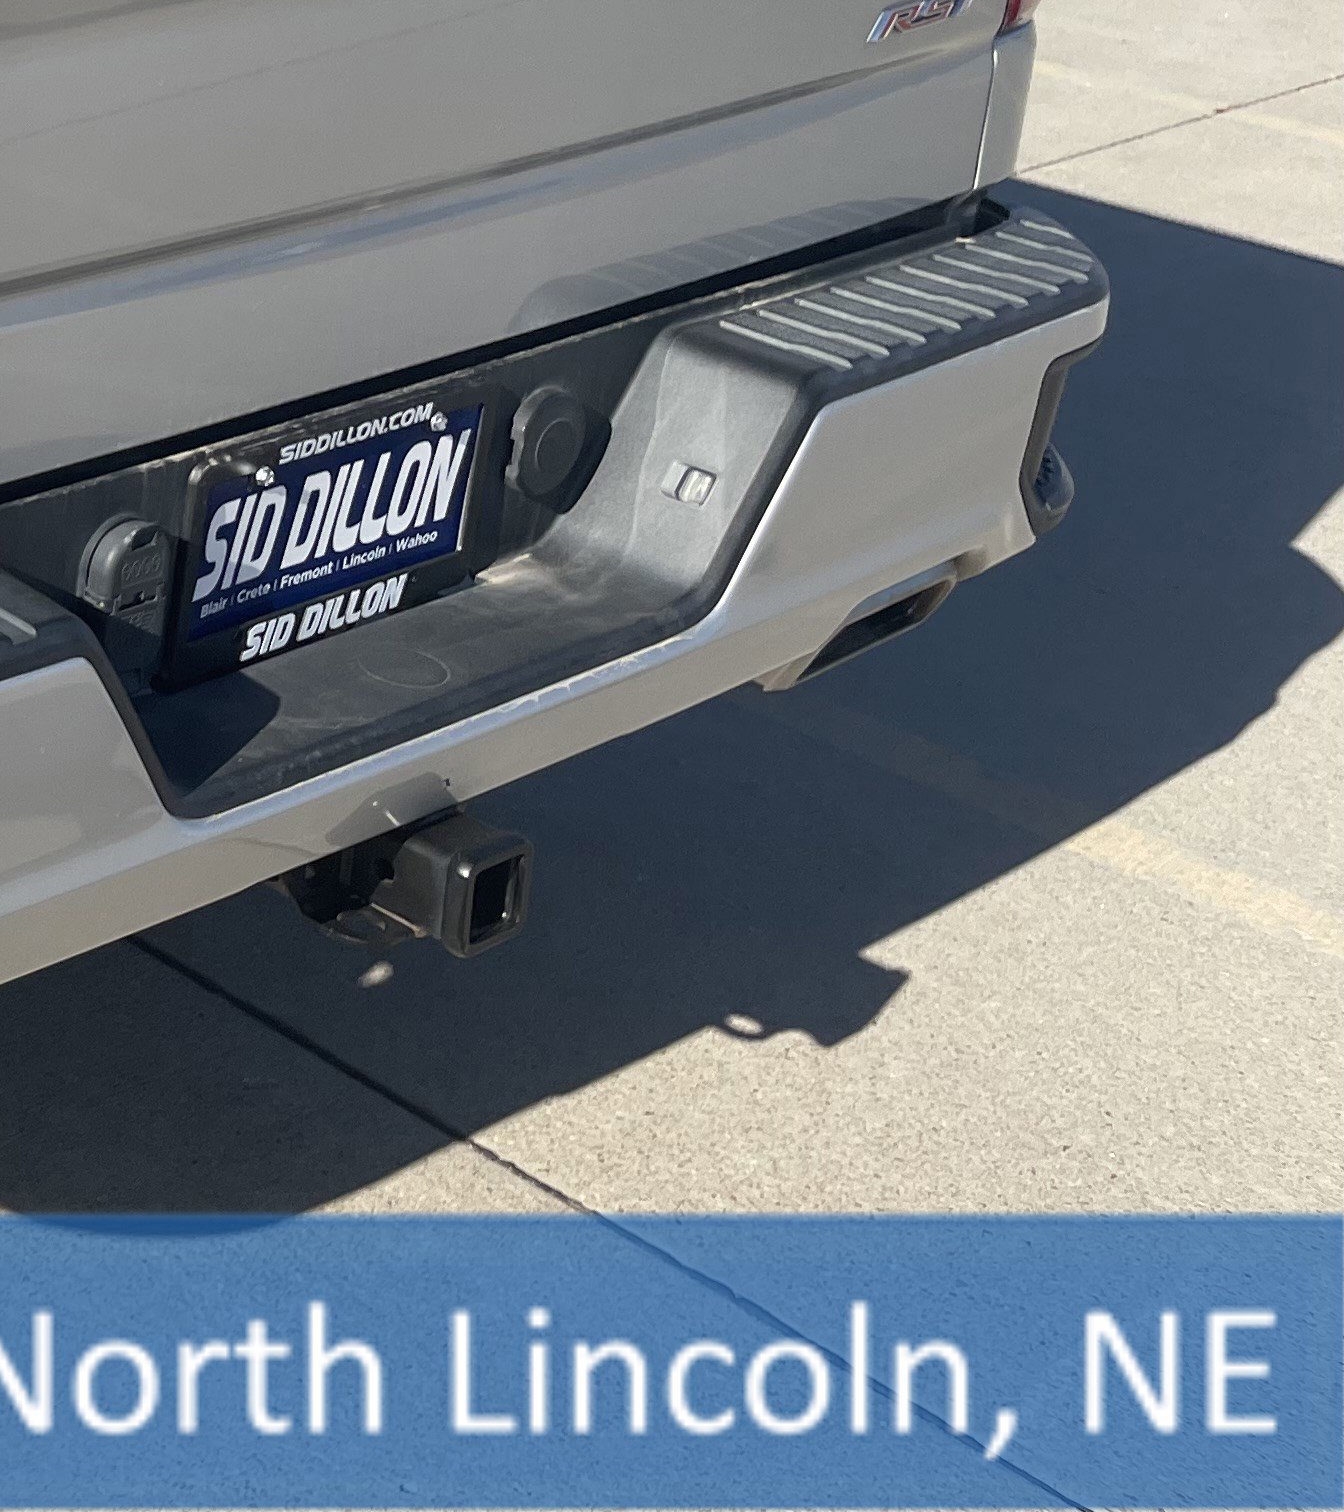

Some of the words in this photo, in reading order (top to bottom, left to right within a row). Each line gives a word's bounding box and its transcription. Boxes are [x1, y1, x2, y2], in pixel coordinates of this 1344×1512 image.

[278, 401, 434, 465] SIDDILLON.COM
[192, 484, 287, 602] SID
[280, 428, 471, 570] DILLON
[200, 597, 228, 619] Blair
[237, 582, 270, 603] Crete
[280, 562, 333, 589] Fremont
[342, 545, 386, 570] Lincoln
[395, 530, 438, 553] Wahoo
[239, 612, 297, 662] SID
[295, 572, 408, 642] DILLON
